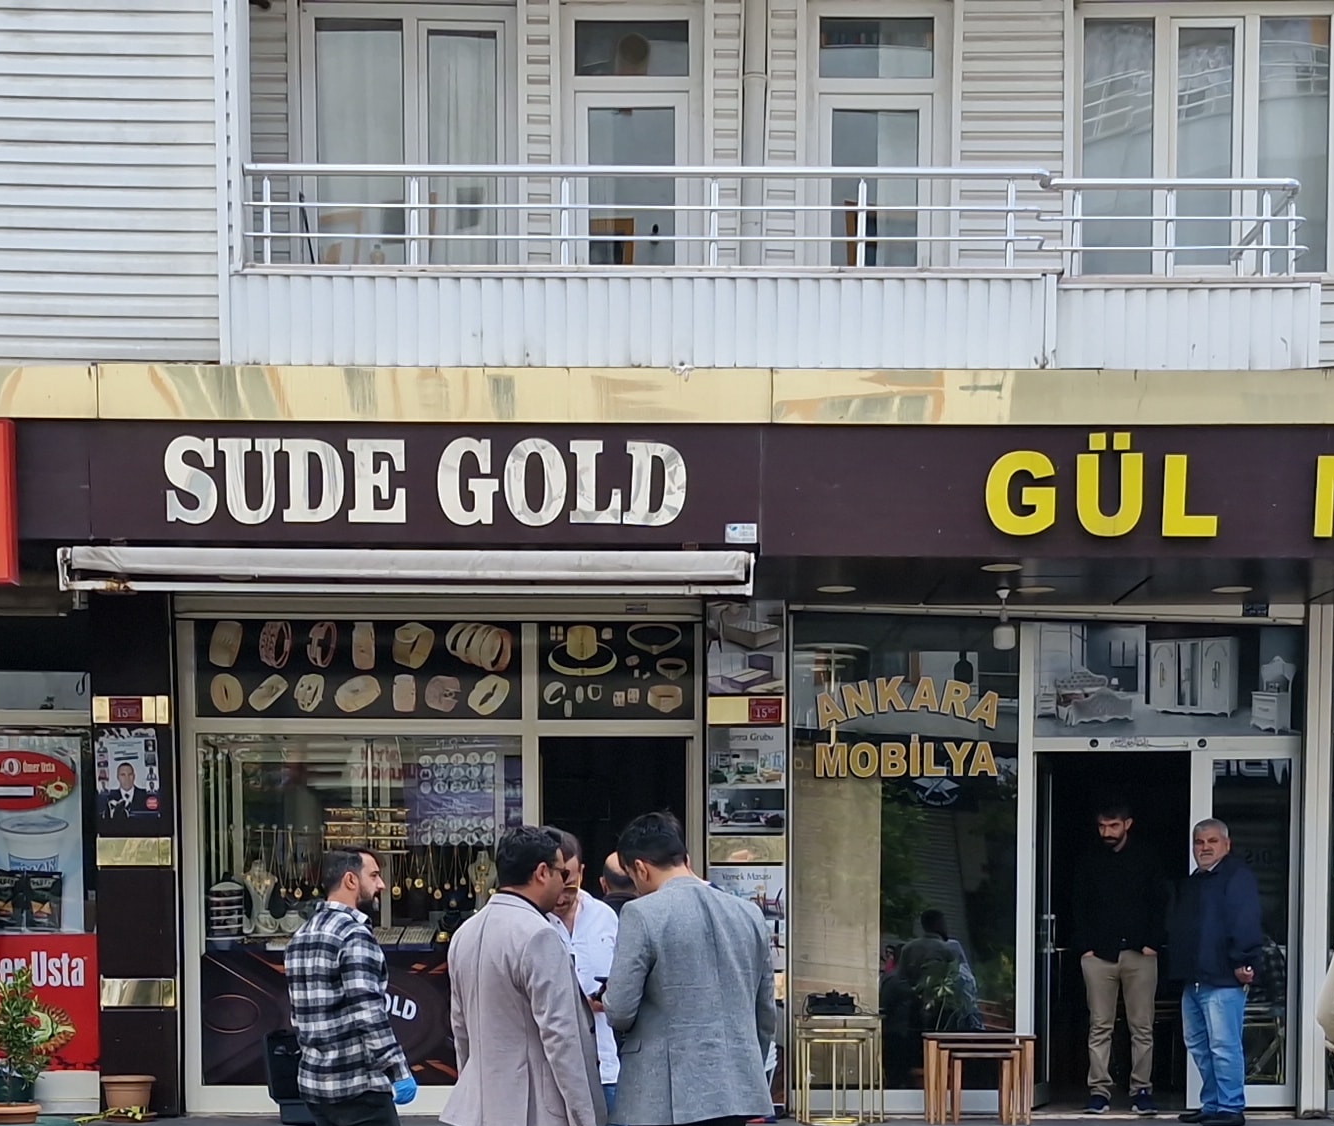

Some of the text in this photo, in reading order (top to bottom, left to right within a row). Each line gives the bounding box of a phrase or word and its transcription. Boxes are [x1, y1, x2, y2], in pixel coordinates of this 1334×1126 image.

[164, 436, 688, 527] SUDE GOLD
[985, 432, 1218, 538] GÜL
[815, 675, 1000, 731] ANKARA
[814, 732, 999, 779] MOBİLYA
[31, 951, 85, 987] Usta
